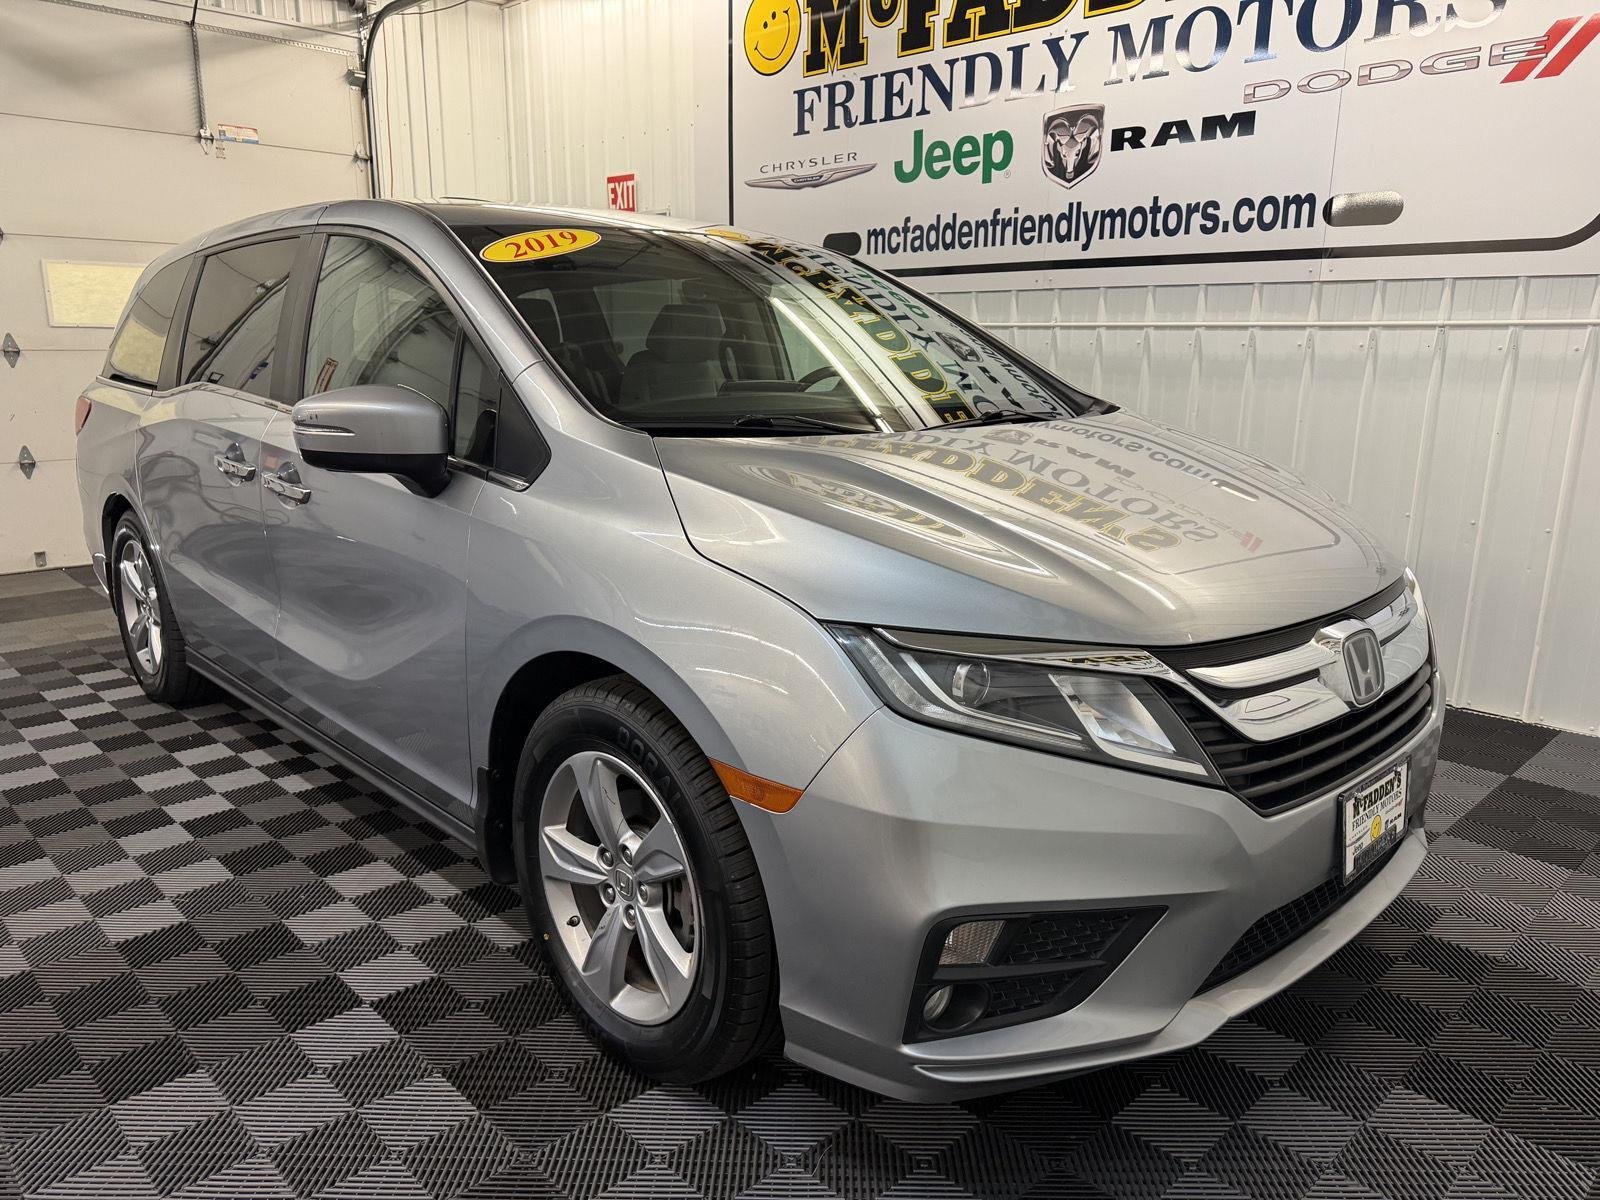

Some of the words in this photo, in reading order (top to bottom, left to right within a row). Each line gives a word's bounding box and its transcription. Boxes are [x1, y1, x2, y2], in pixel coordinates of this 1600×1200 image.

[793, 31, 1089, 136] FRIENDLY
[1243, 34, 1550, 104] DODGE
[1110, 110, 1256, 151] RAM
[760, 151, 858, 175] CHRYSLER
[894, 129, 1014, 184] Jeep
[607, 181, 635, 210] EXIT
[505, 230, 579, 259] 2019
[867, 192, 1317, 255] mcfaddenfriendlymotors.com
